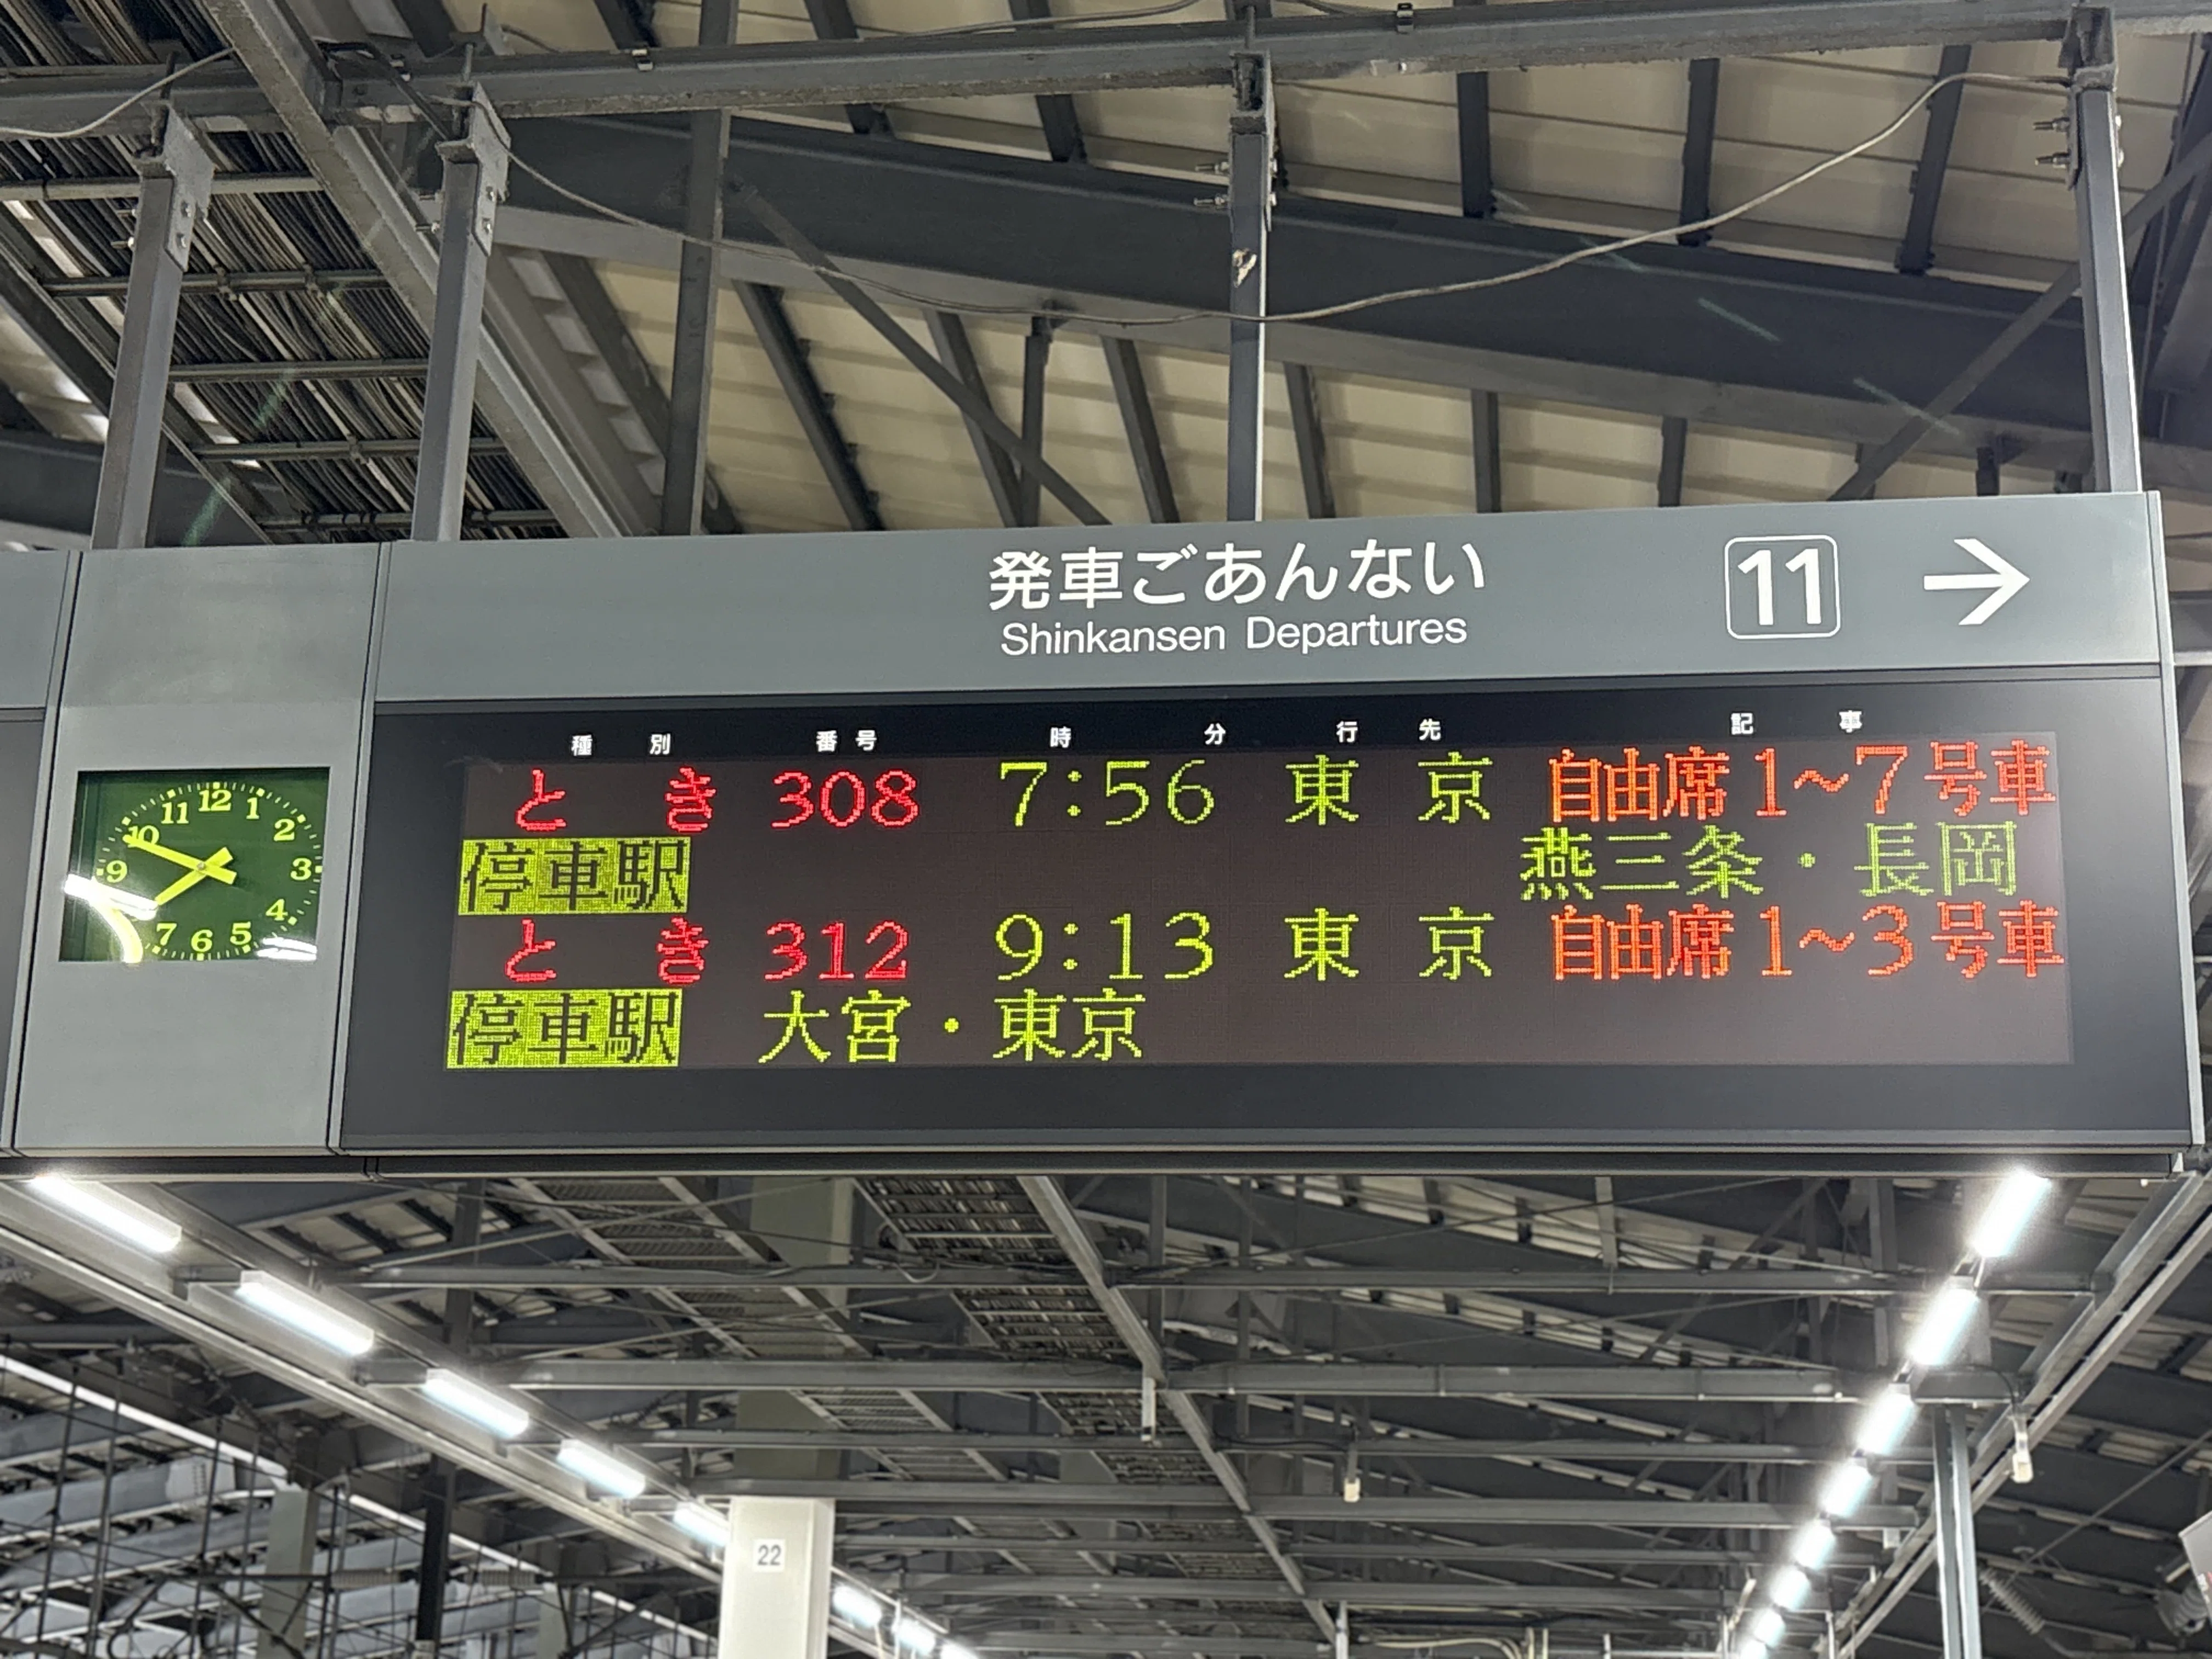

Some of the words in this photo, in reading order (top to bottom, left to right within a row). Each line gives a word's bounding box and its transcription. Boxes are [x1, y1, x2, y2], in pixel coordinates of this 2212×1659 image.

[989, 539, 1485, 610] 発車ごあんない
[1737, 549, 1821, 625] 11
[1001, 621, 1226, 656] Shinkansen
[1246, 614, 1467, 654] Departures
[198, 789, 232, 812] 12
[772, 770, 918, 827] 308
[1000, 759, 1214, 826] 7:56
[161, 802, 189, 825] 11
[246, 797, 259, 820] 1
[128, 825, 160, 848] 10
[273, 818, 295, 842] 2
[106, 860, 128, 883] 9
[290, 857, 312, 881] 3
[465, 840, 685, 911] 停車駅
[265, 898, 288, 921] 4
[156, 923, 177, 946] 7
[190, 929, 213, 952] 6
[229, 921, 252, 946] 5
[765, 921, 907, 980] 312
[995, 912, 1213, 980] 9:13
[453, 991, 678, 1065] 停車駅
[758, 1544, 781, 1566] 22
